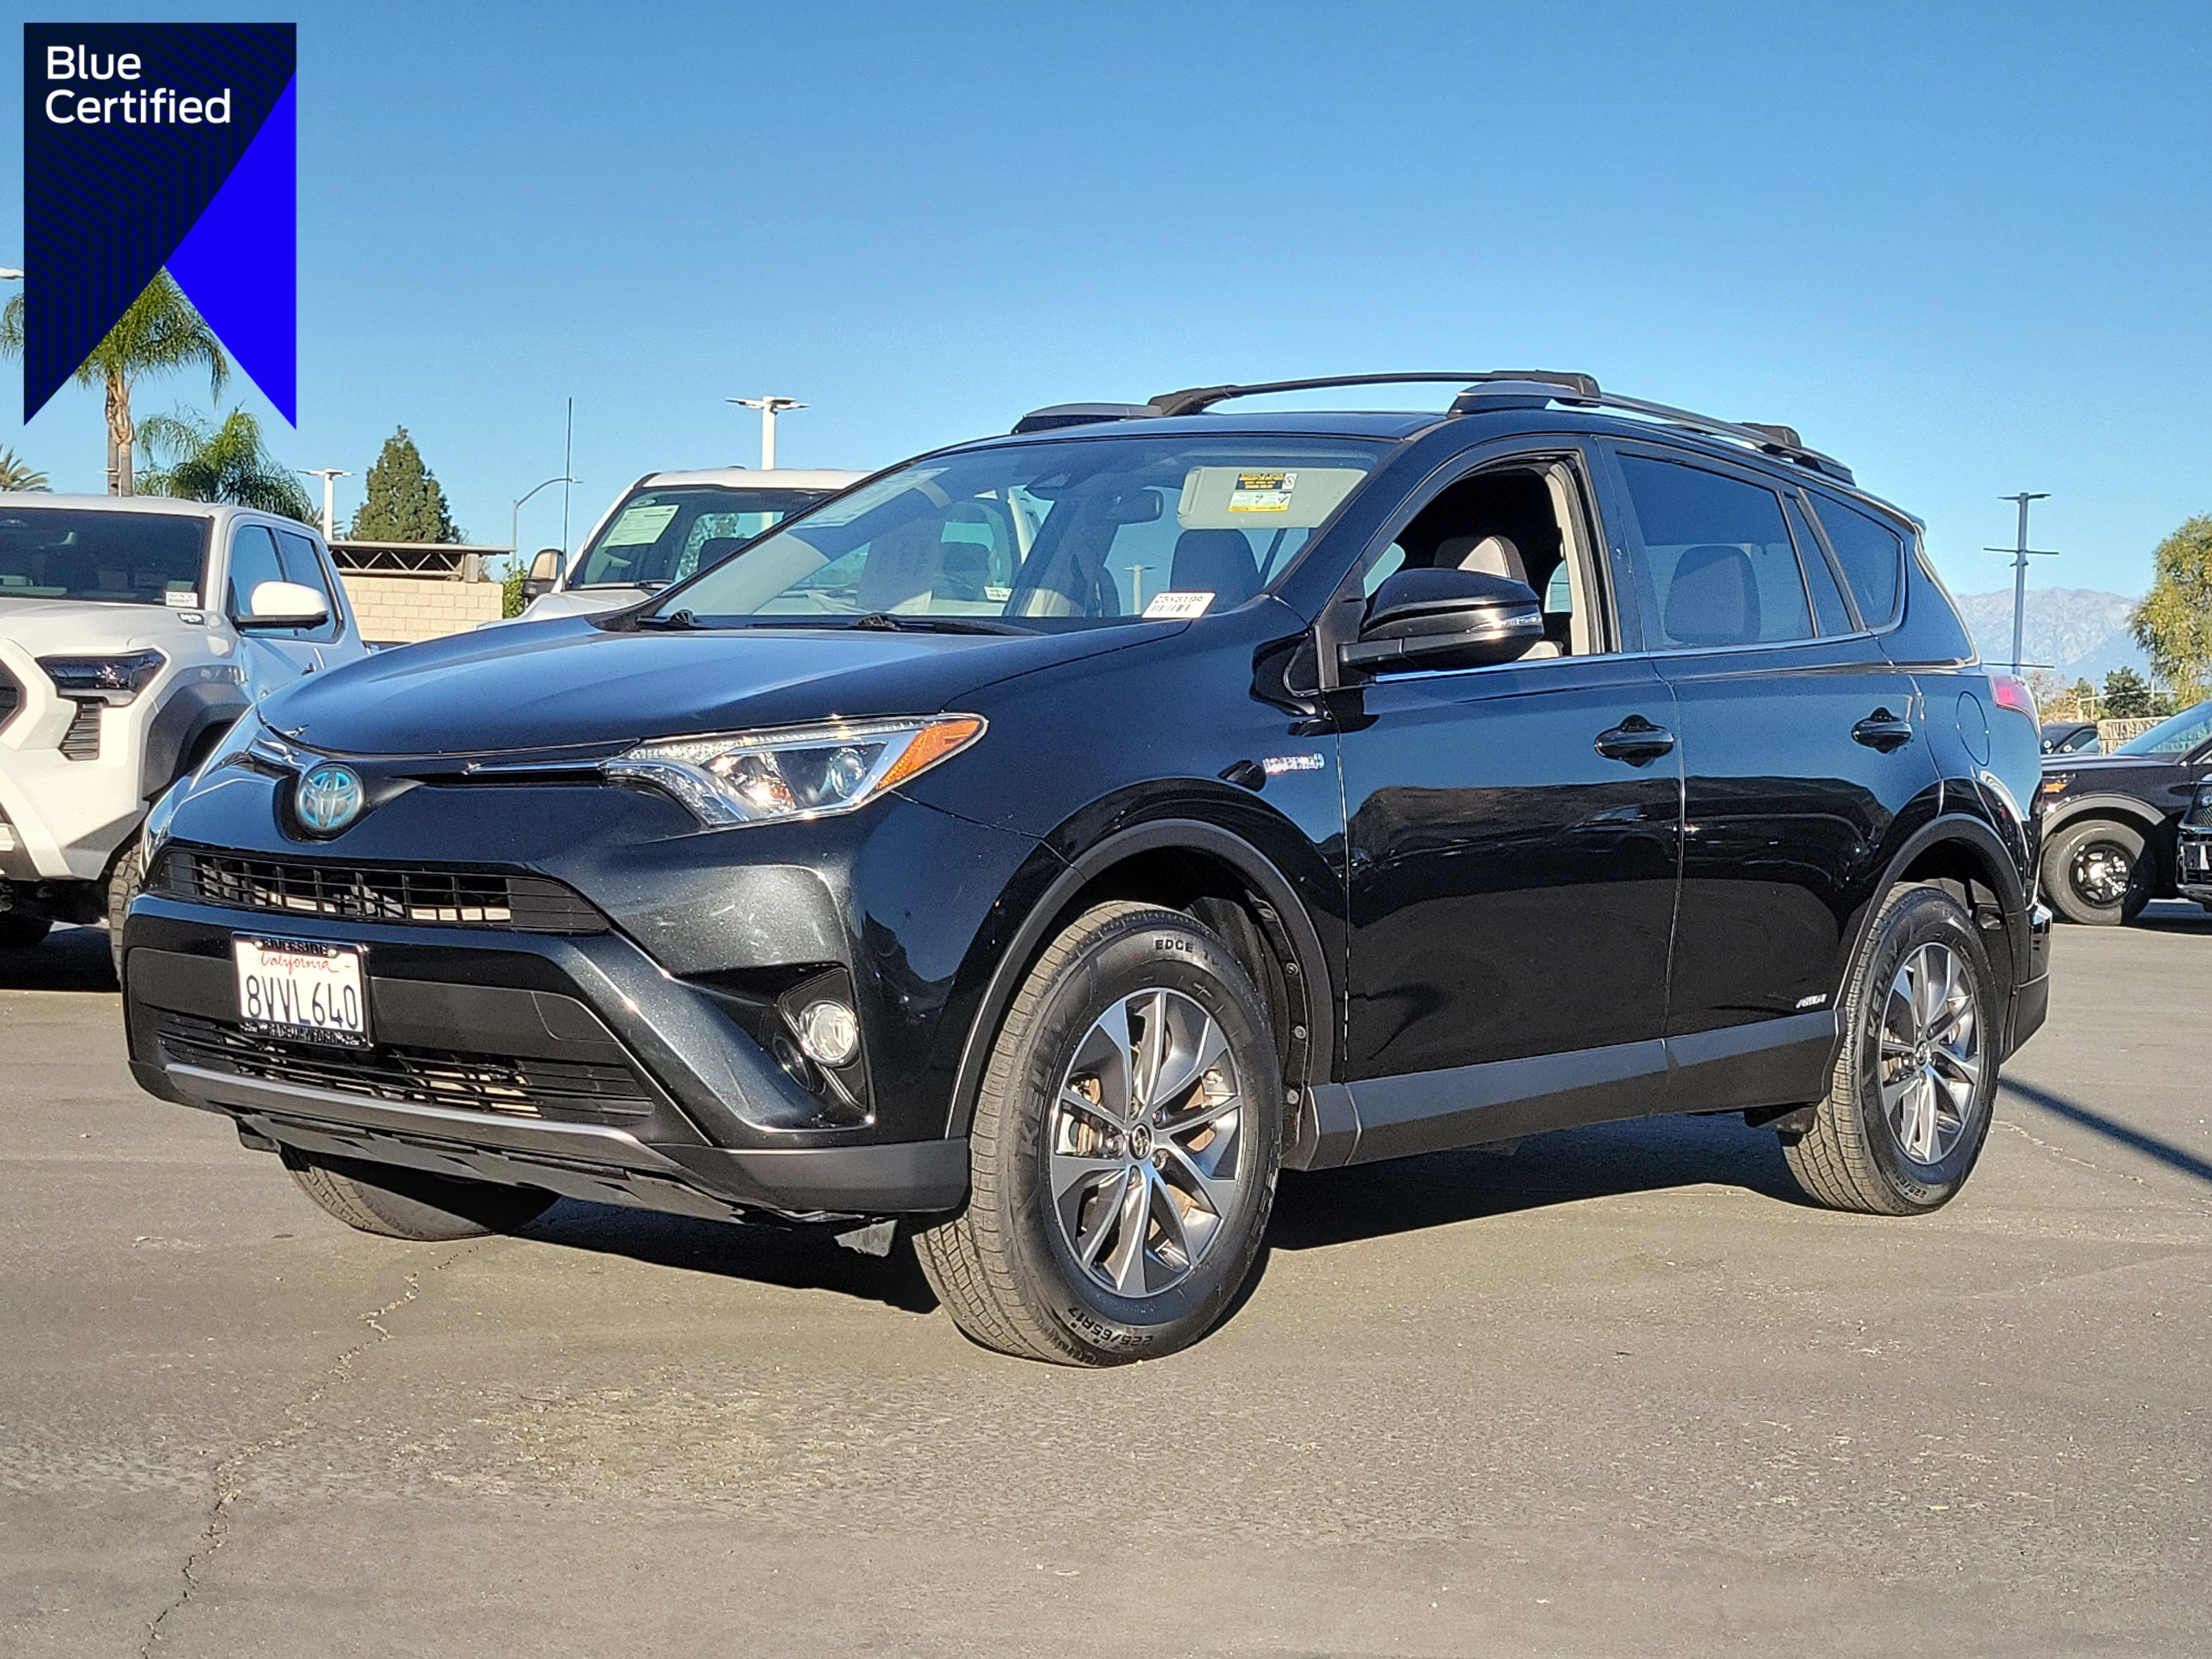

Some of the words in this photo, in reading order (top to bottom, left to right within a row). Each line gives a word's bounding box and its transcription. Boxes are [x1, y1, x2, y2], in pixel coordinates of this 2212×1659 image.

[1155, 939, 1194, 953] EDGE
[261, 950, 340, 975] California
[246, 974, 358, 1030] 8VVL640
[1068, 1307, 1154, 1346] 225/65R17
